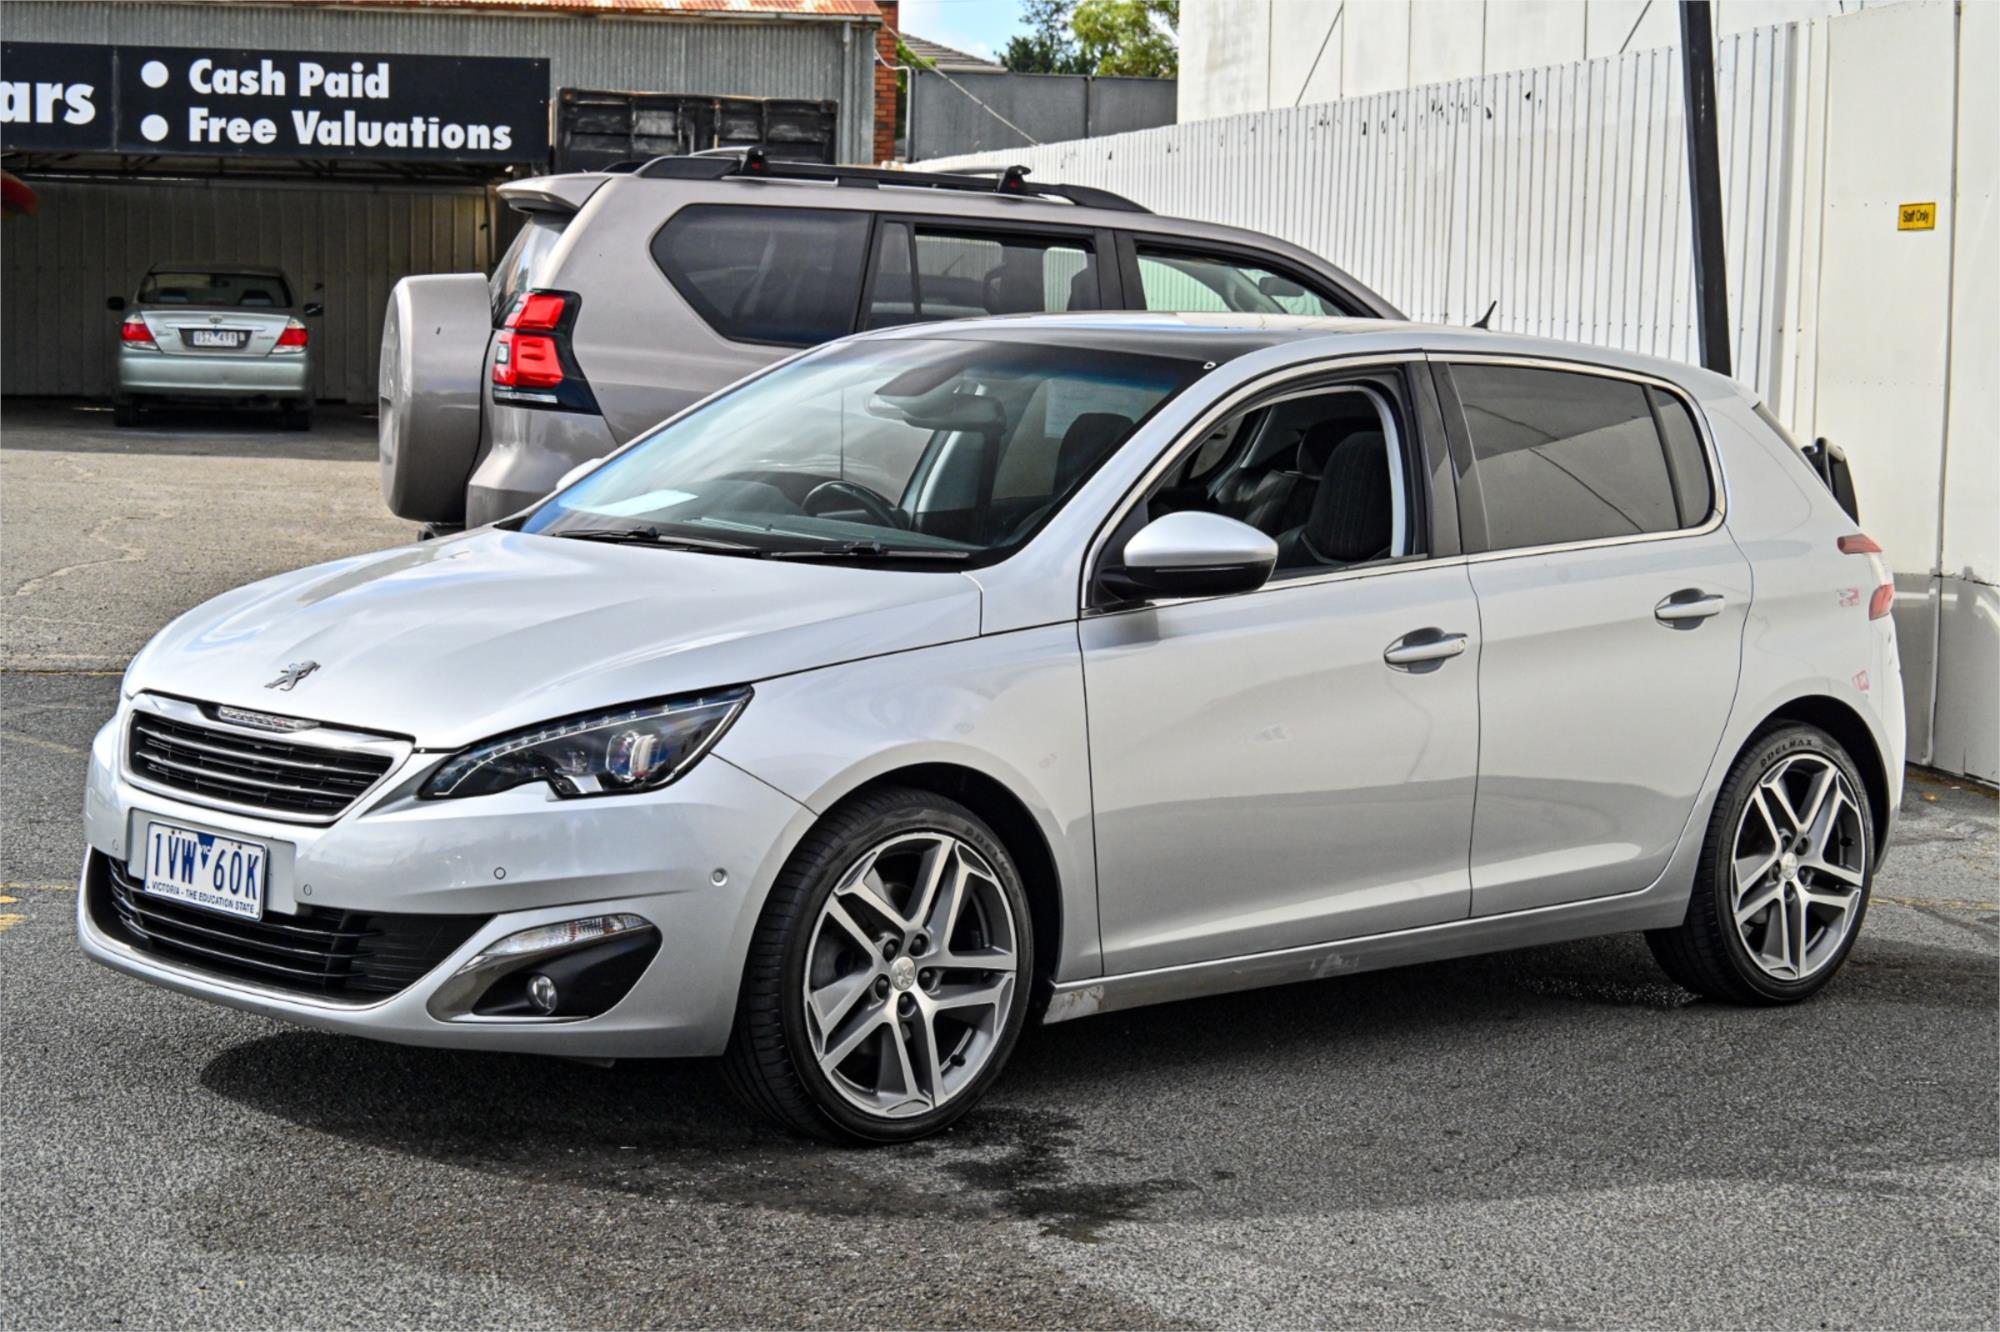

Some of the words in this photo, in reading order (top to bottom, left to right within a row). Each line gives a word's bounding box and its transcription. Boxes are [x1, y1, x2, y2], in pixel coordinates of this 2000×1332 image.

[188, 58, 286, 96] Cash
[299, 61, 390, 99] Paid
[188, 107, 278, 144] Free
[291, 110, 513, 151] Valuations
[151, 880, 180, 895] VICTORIA
[185, 888, 197, 900] THE
[198, 892, 234, 909] EDUCATION
[234, 900, 256, 914] STATE
